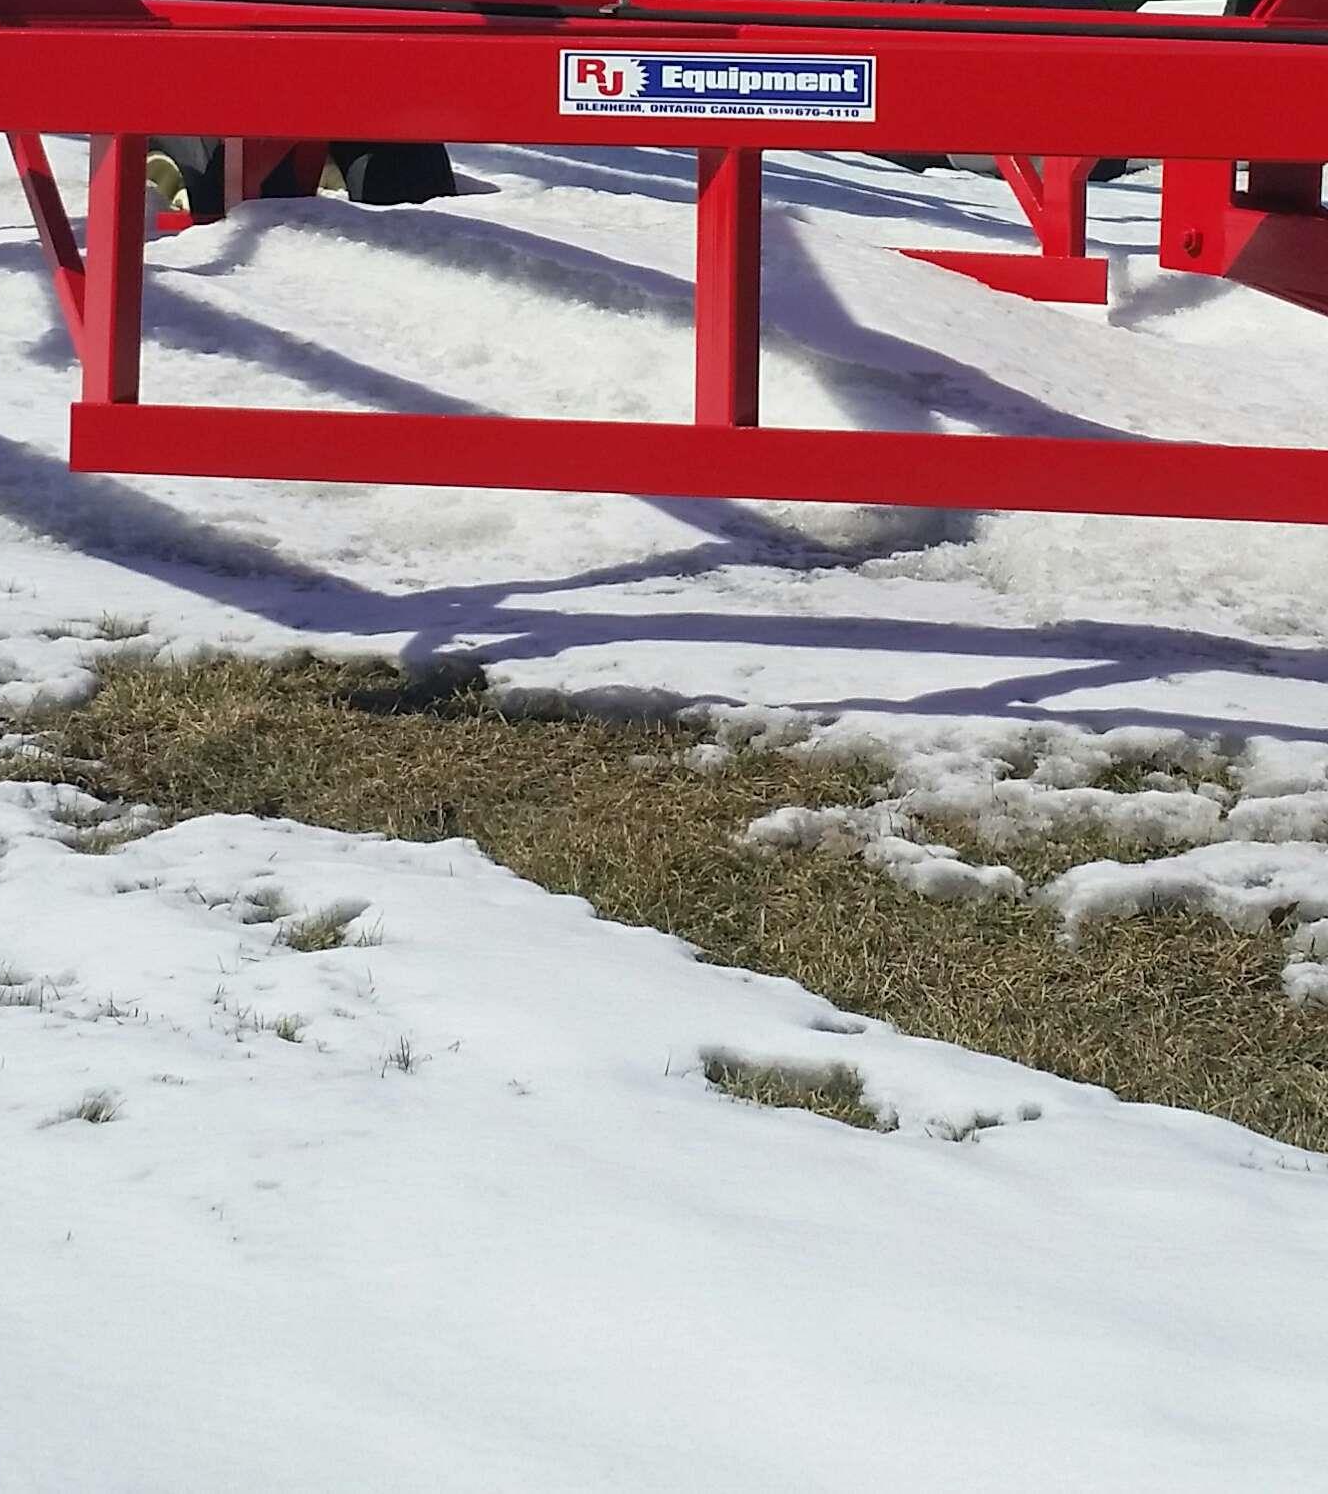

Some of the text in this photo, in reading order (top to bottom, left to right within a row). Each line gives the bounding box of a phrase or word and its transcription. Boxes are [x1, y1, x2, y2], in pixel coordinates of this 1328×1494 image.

[576, 58, 859, 97] RJ Equipment
[650, 103, 706, 115] ONTARIO
[710, 105, 765, 116] CANADA
